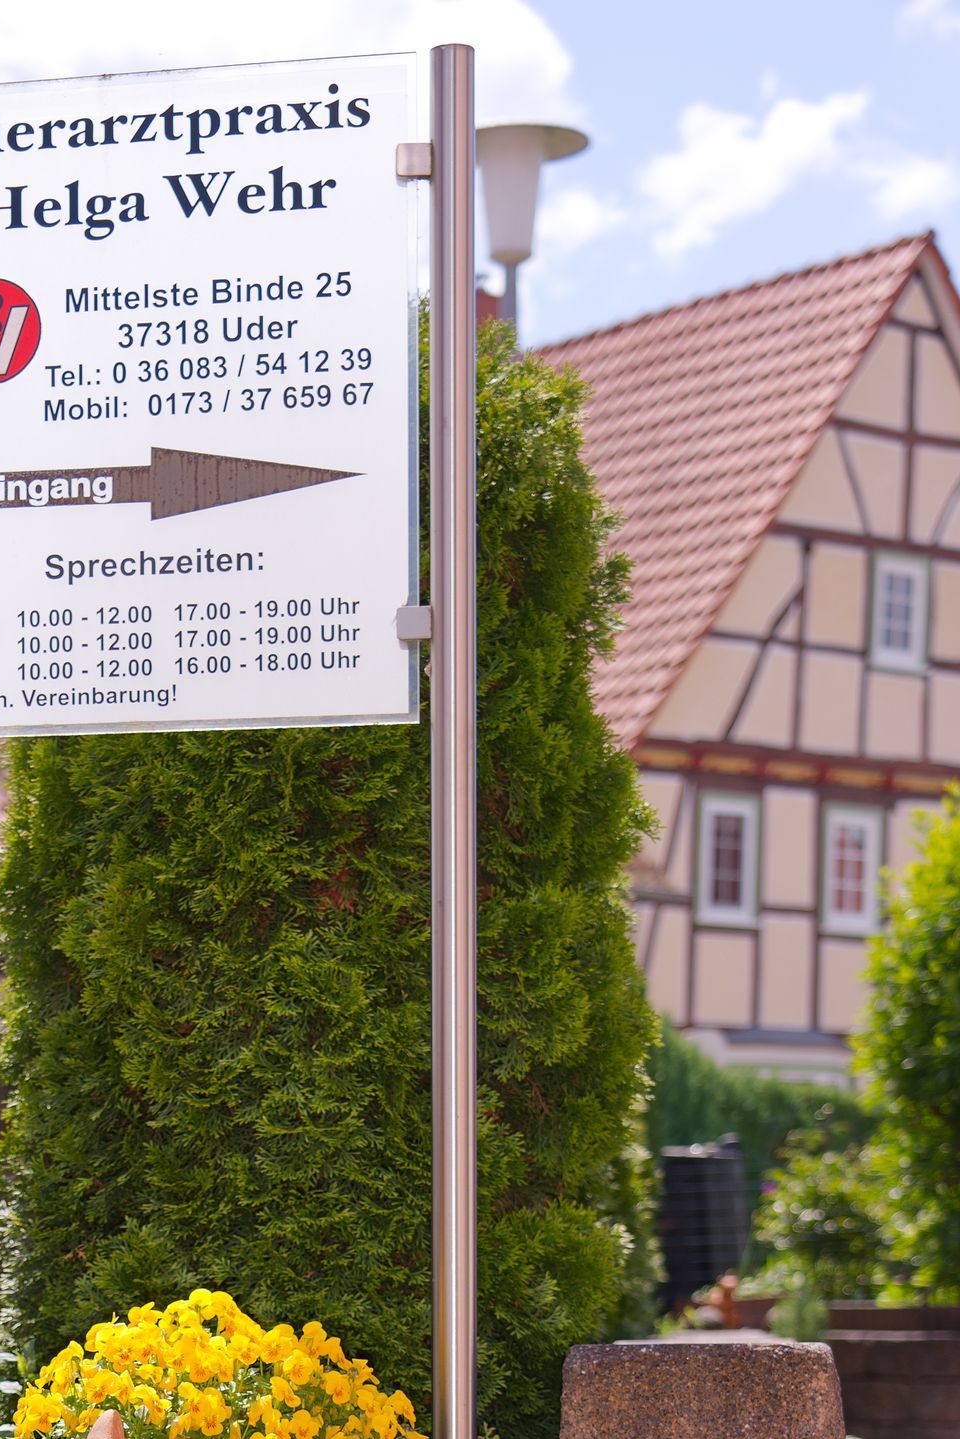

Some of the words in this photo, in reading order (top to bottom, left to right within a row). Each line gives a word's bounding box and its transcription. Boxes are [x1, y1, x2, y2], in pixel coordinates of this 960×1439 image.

[162, 165, 337, 219] Wehr
[65, 283, 199, 313] Mittelste
[212, 275, 304, 305] Binde
[315, 271, 352, 298] 25
[118, 318, 209, 349] 37318
[222, 315, 299, 343] Uder
[44, 363, 101, 388] Tel.:
[112, 361, 127, 384] 0
[137, 359, 169, 383] 36
[179, 355, 228, 381] 083
[237, 354, 246, 378] /
[255, 352, 288, 376] 54
[298, 349, 329, 374] 12
[340, 347, 372, 372] 39
[44, 395, 128, 422] Mobil:
[148, 390, 213, 417] 0173
[222, 389, 231, 413] /
[240, 387, 272, 412] 37
[283, 384, 332, 409] 659
[342, 382, 374, 406] 67
[44, 547, 264, 586] Sprechzeiten:
[17, 608, 73, 628] 10.00
[96, 605, 152, 625] 12.00
[174, 601, 231, 622] 17.00
[254, 598, 312, 619] 19.00
[320, 597, 360, 616] Uhr
[17, 634, 73, 655] 10.00
[96, 631, 153, 652] 12.00
[174, 628, 231, 649] 17.00
[254, 625, 312, 645] 19.00
[320, 623, 361, 643] Uhr
[17, 661, 73, 681] 10.00
[96, 658, 153, 678] 12.00
[174, 655, 232, 675] 16.00
[254, 652, 312, 672] 18.00
[320, 650, 361, 670] Uhr
[21, 683, 177, 707] Vereinbarung!
